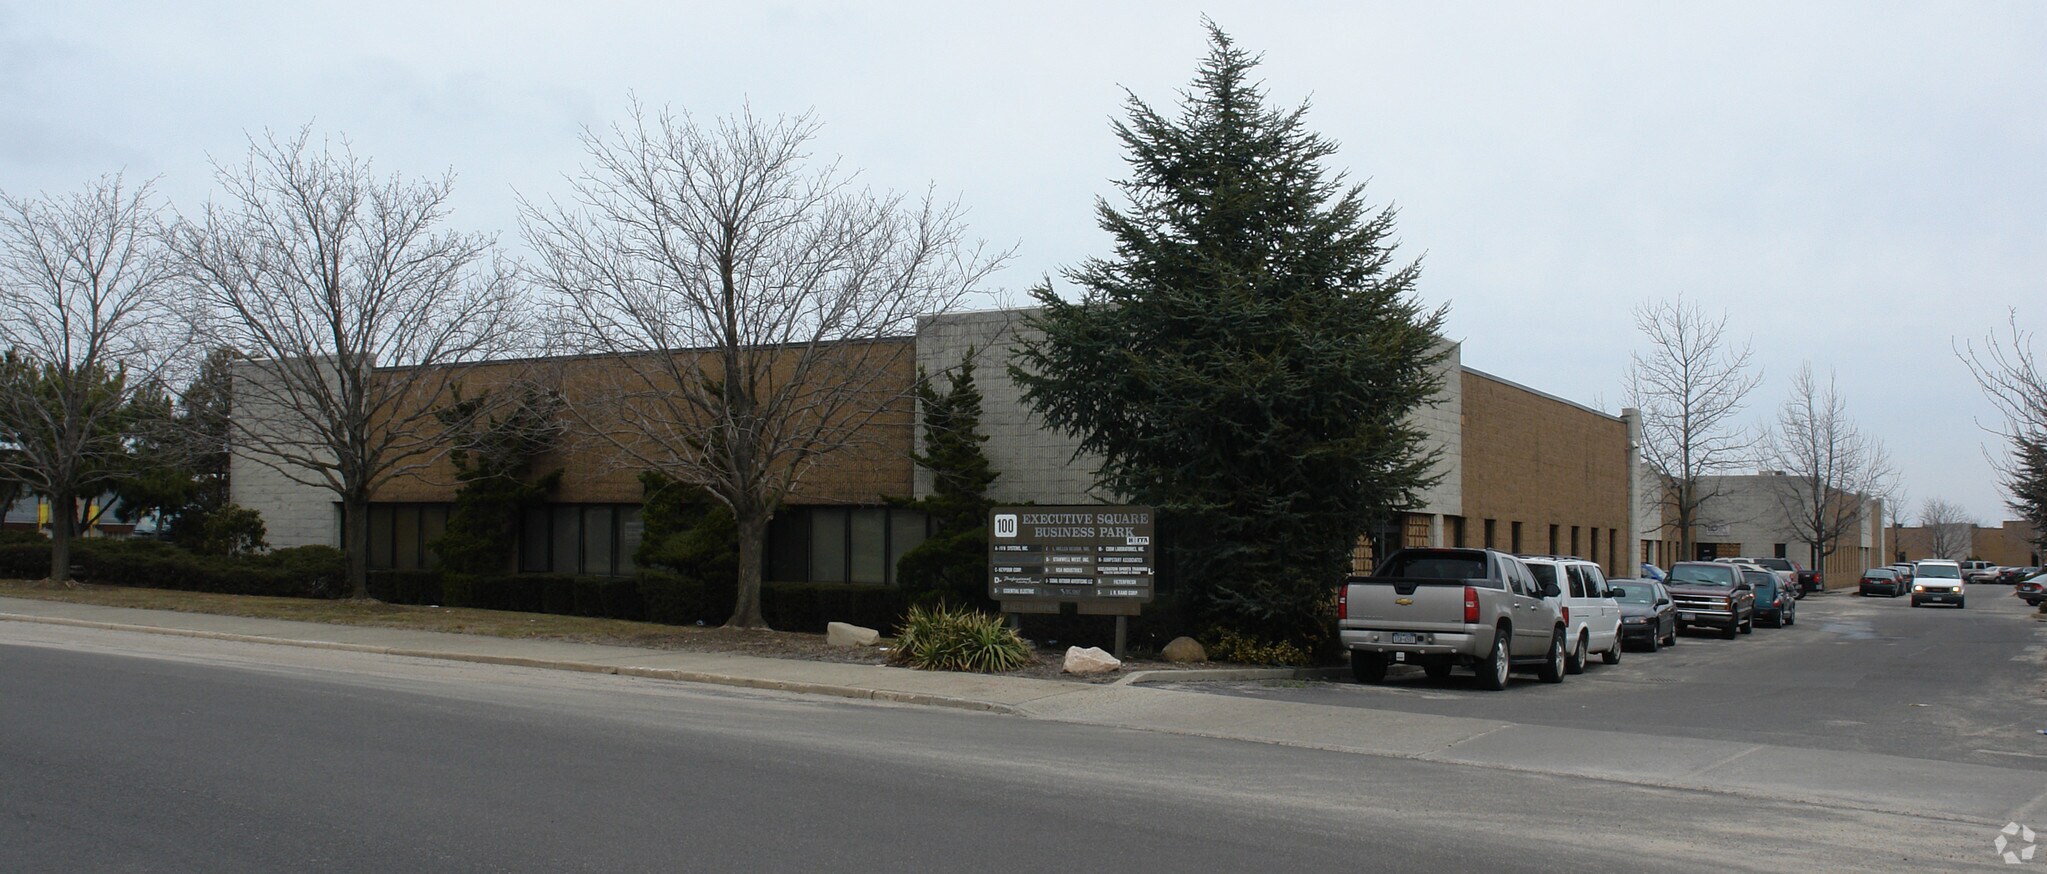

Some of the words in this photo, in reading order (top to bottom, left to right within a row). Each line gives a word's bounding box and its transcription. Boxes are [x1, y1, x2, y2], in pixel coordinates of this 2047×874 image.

[1022, 513, 1093, 524] EXECUTIVE
[1097, 513, 1149, 525] SQUARE
[997, 518, 1014, 533] 100
[1034, 527, 1095, 538] BUSINESS
[1099, 527, 1136, 538] PARK
